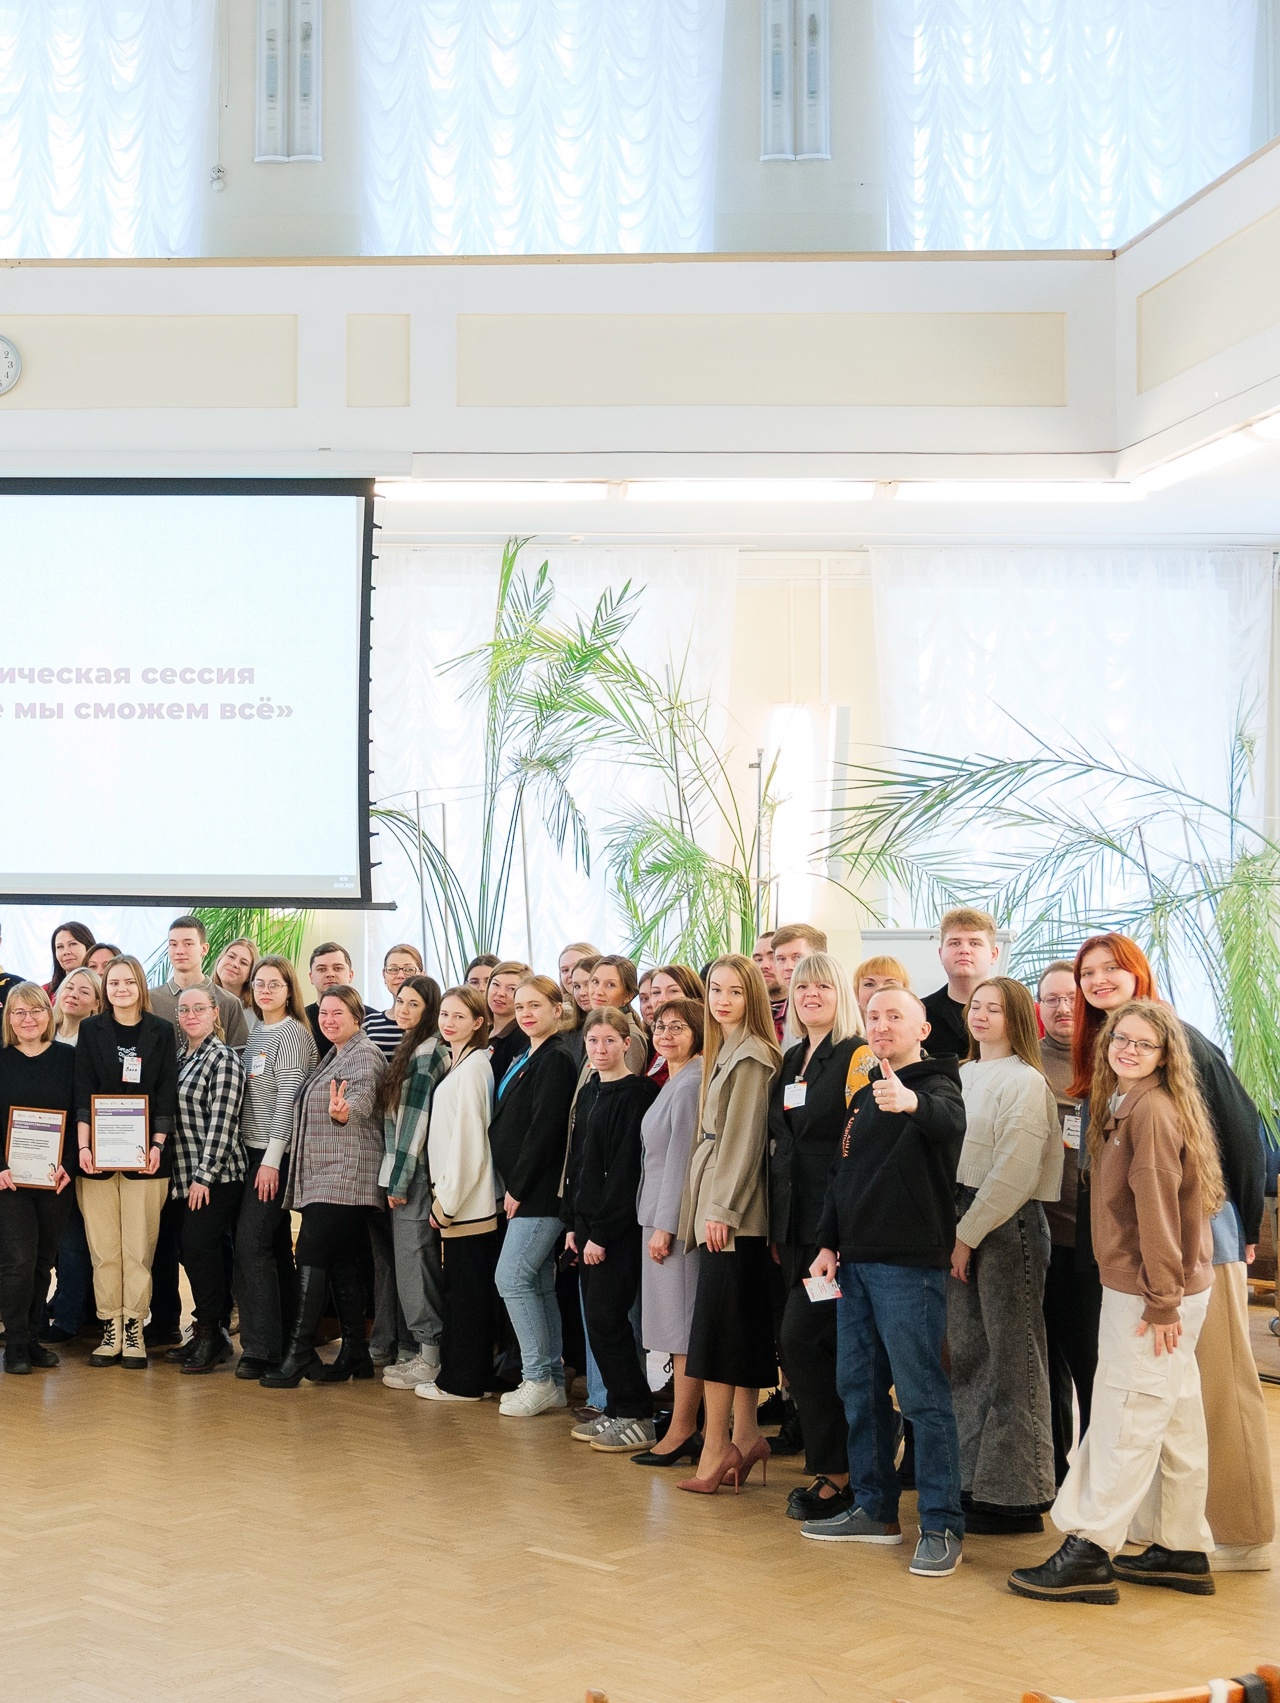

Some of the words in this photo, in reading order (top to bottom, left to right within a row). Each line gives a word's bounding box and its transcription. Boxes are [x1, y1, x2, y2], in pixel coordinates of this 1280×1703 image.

[141, 667, 255, 685] сессия
[14, 702, 64, 719] мы
[74, 702, 209, 720] сможем
[220, 696, 294, 720] всё»
